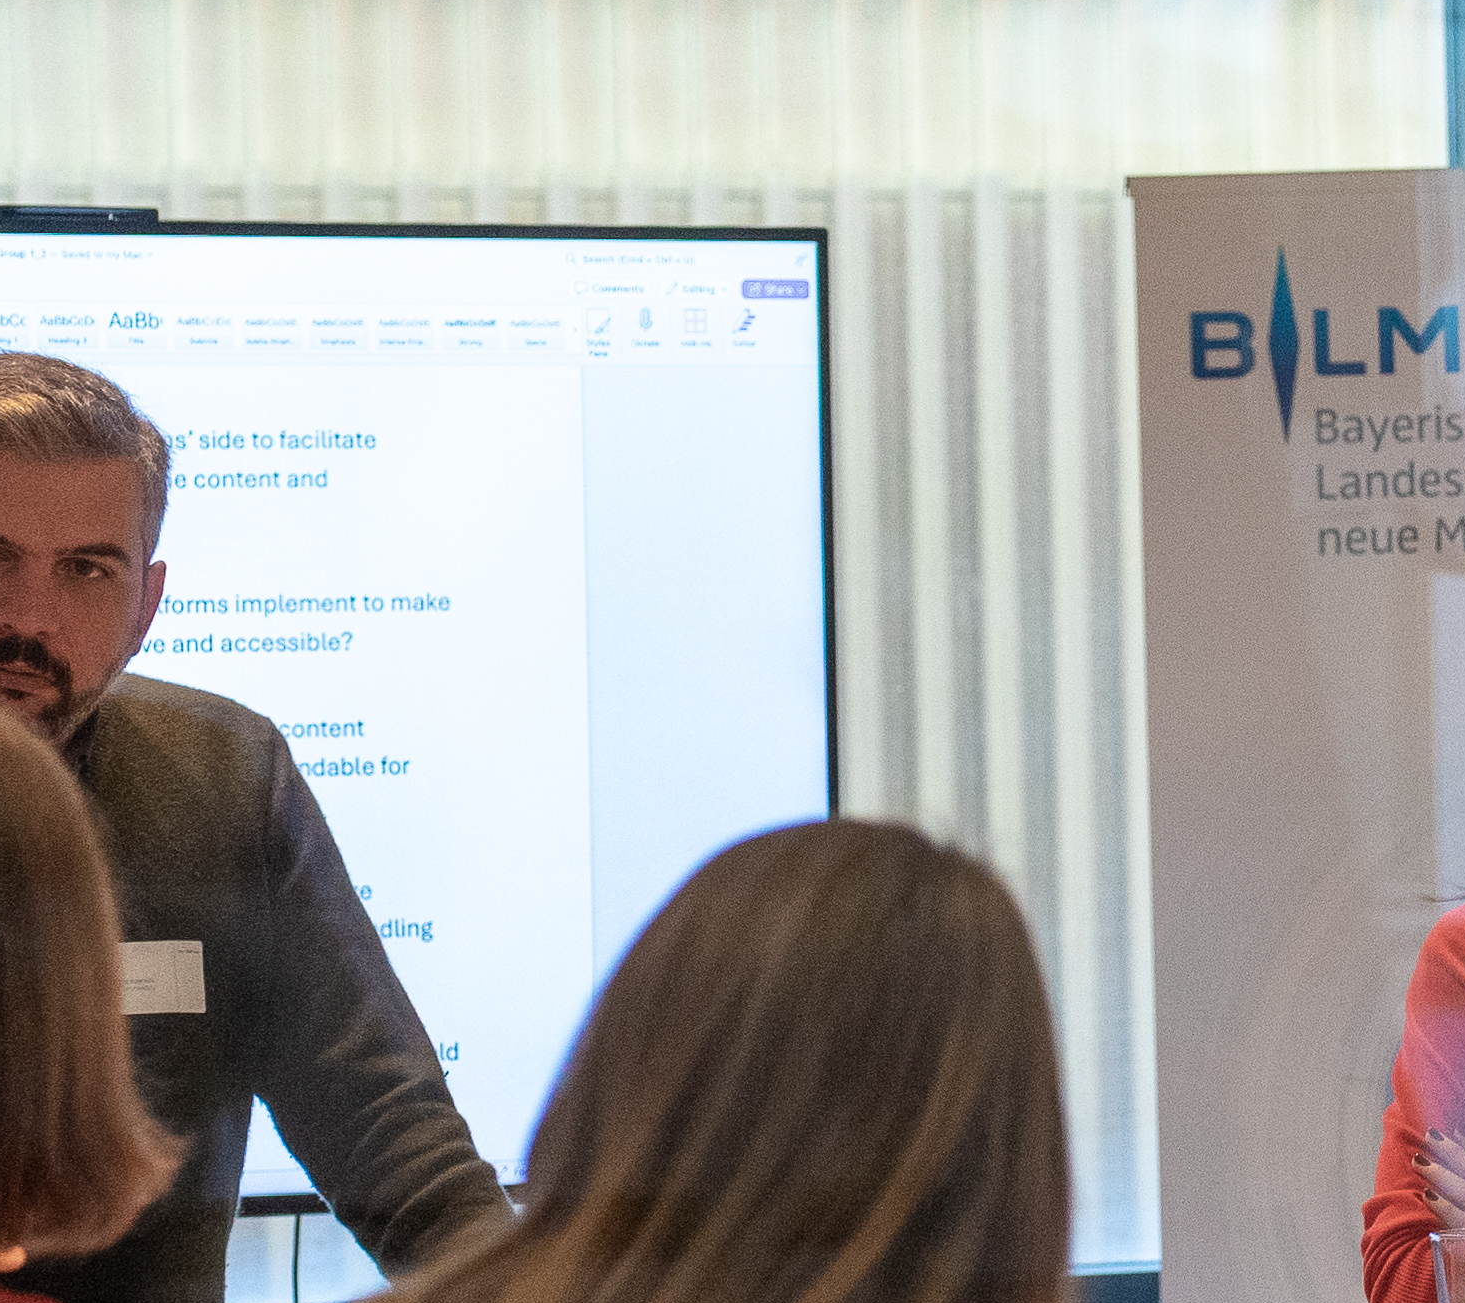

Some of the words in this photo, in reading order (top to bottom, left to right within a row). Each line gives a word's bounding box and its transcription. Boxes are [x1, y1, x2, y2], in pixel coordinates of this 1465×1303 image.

[199, 431, 245, 450] side
[252, 433, 273, 450] to
[279, 430, 377, 450] facilitate
[193, 472, 280, 489] content
[287, 470, 328, 488] and
[1316, 525, 1420, 557] neue
[235, 594, 357, 617] implement
[363, 595, 385, 612] to
[391, 592, 451, 611] make
[173, 633, 214, 653] and
[220, 631, 354, 653] accessible?
[279, 721, 364, 739] content
[381, 755, 410, 776] for
[375, 919, 434, 942] dling
